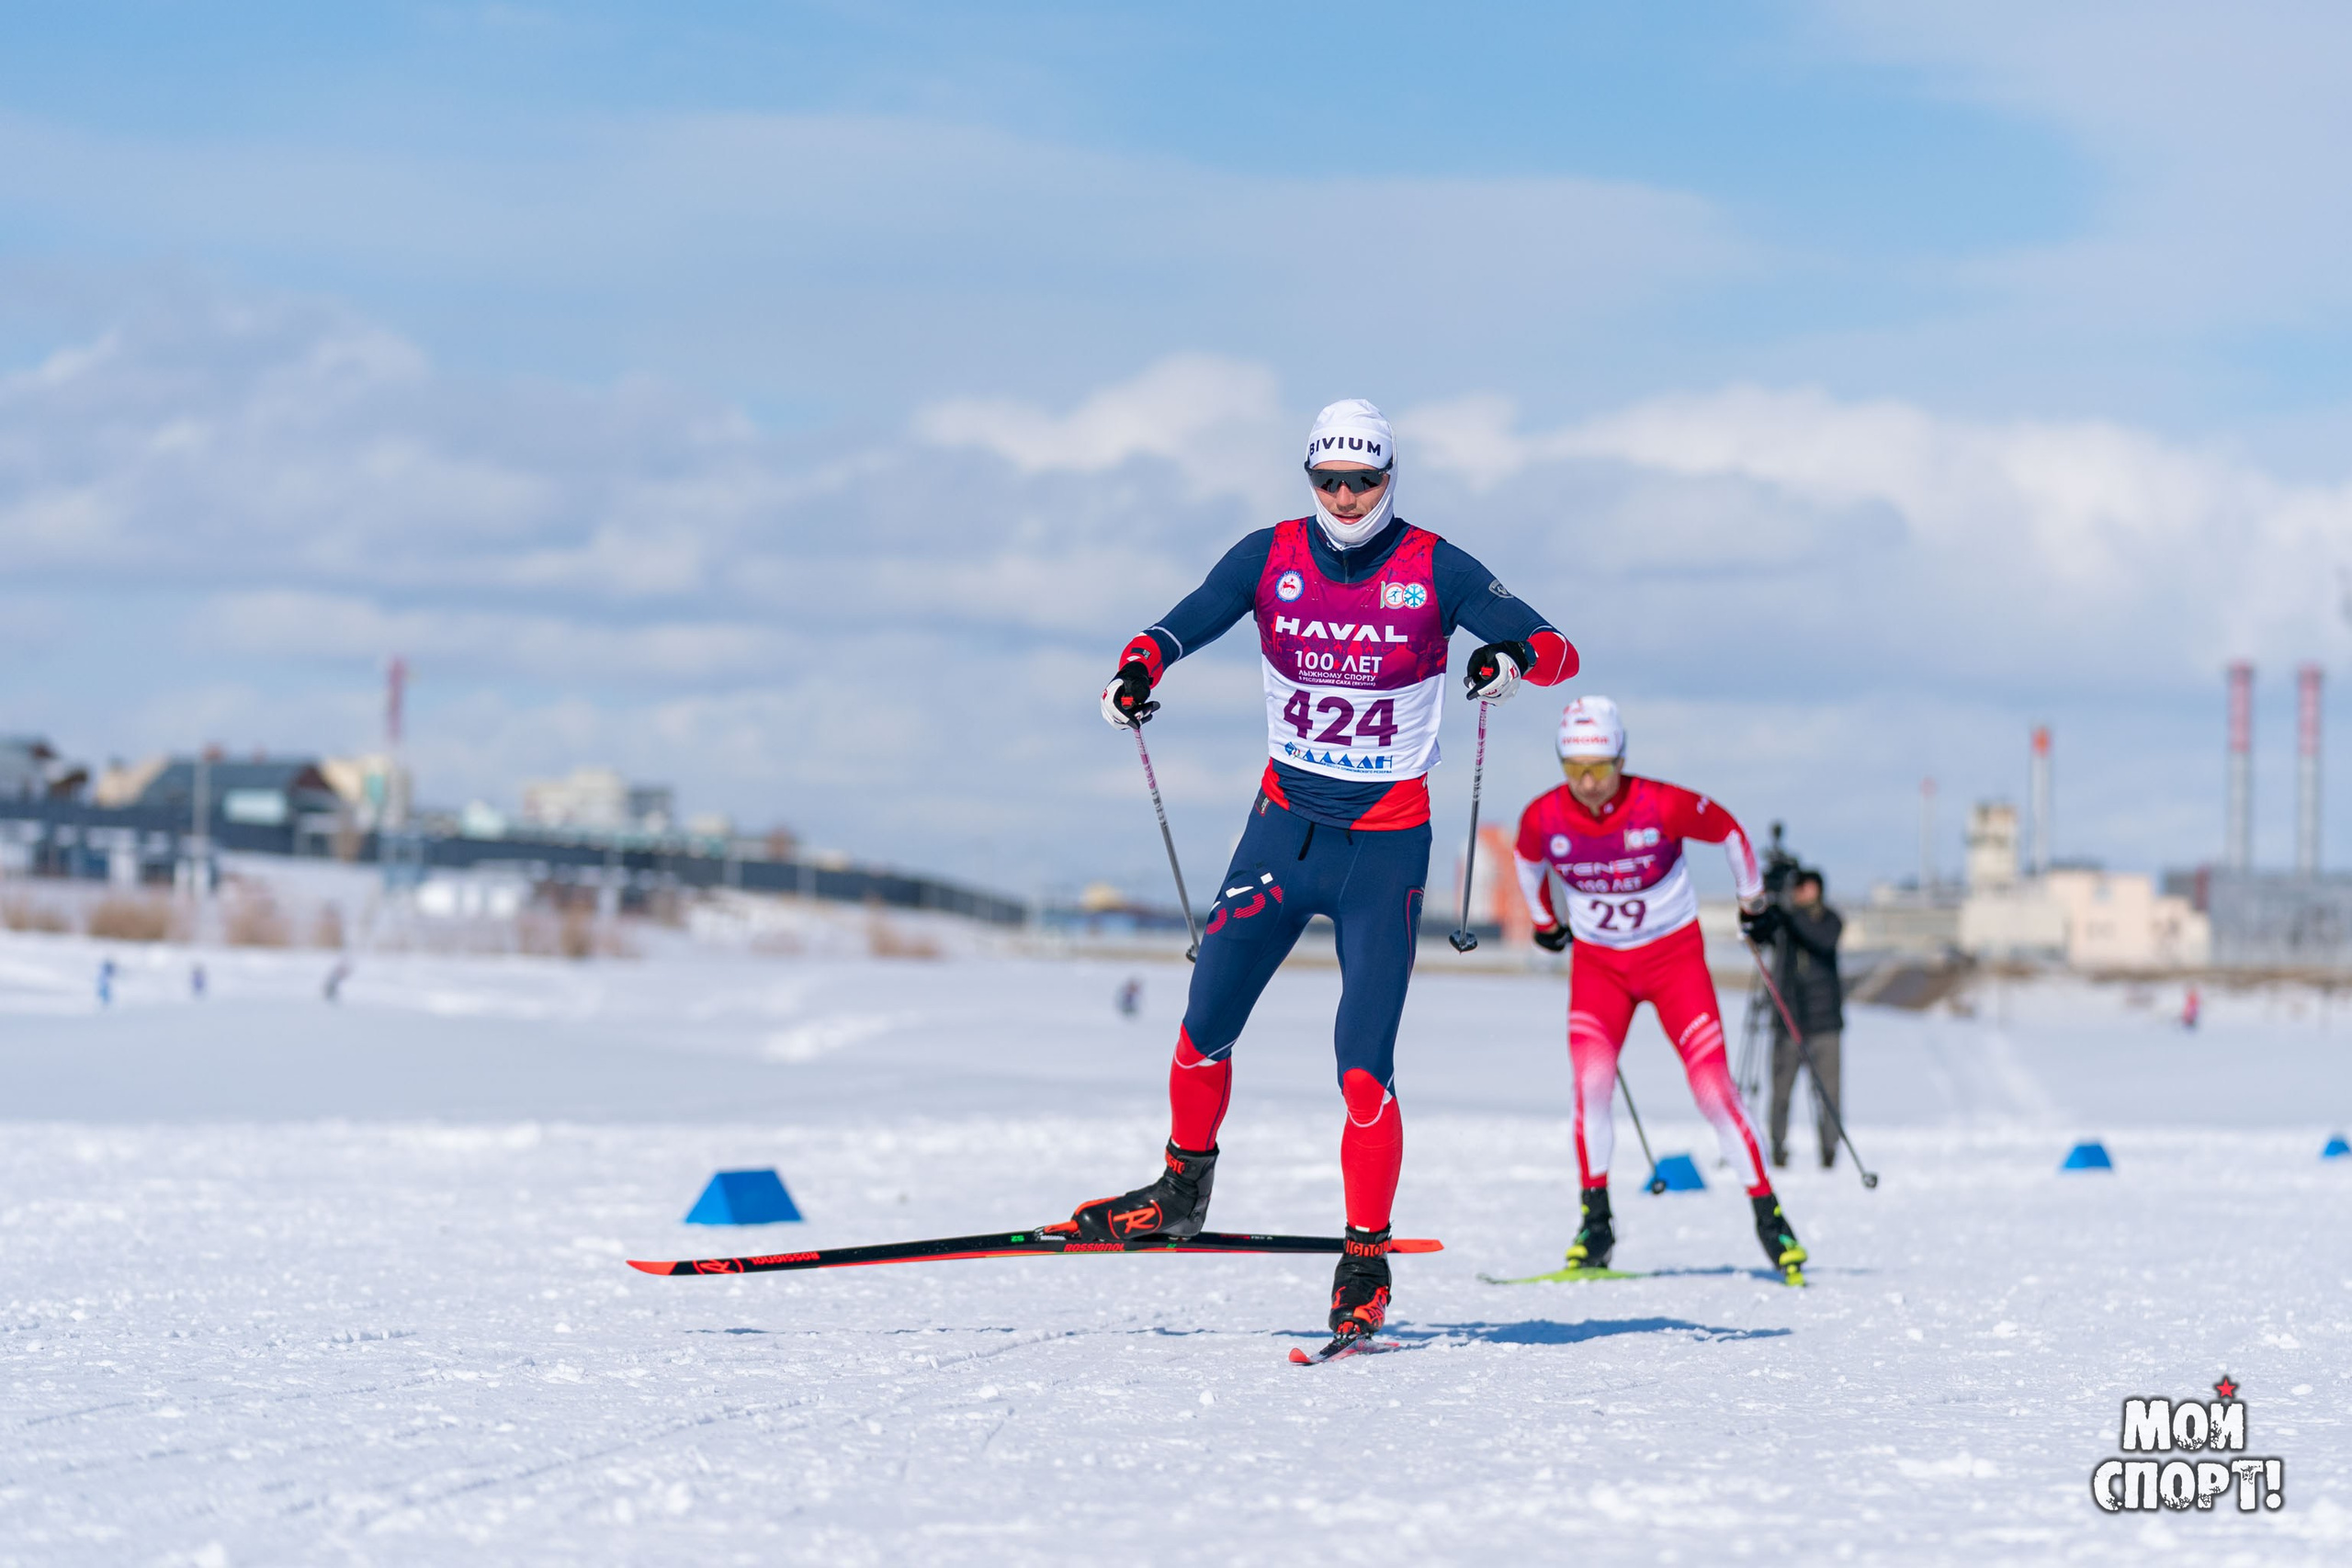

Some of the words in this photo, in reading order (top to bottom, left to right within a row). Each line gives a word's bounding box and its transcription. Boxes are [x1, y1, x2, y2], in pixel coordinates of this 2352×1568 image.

[1309, 436, 1382, 457] BIVIUM
[1274, 615, 1408, 643] HAVAL
[1295, 650, 1334, 671] 100
[1341, 655, 1383, 673] ЛЕТ
[1298, 670, 1342, 679] ЛЫЖНОМУ
[1343, 673, 1376, 682] СПОРТУ
[1283, 689, 1398, 747] 424
[1577, 879, 1609, 893] 100
[1589, 899, 1646, 931] 29
[1063, 1243, 1125, 1252] ROSSIGNOL
[747, 1251, 820, 1266] ROSSIGNOL
